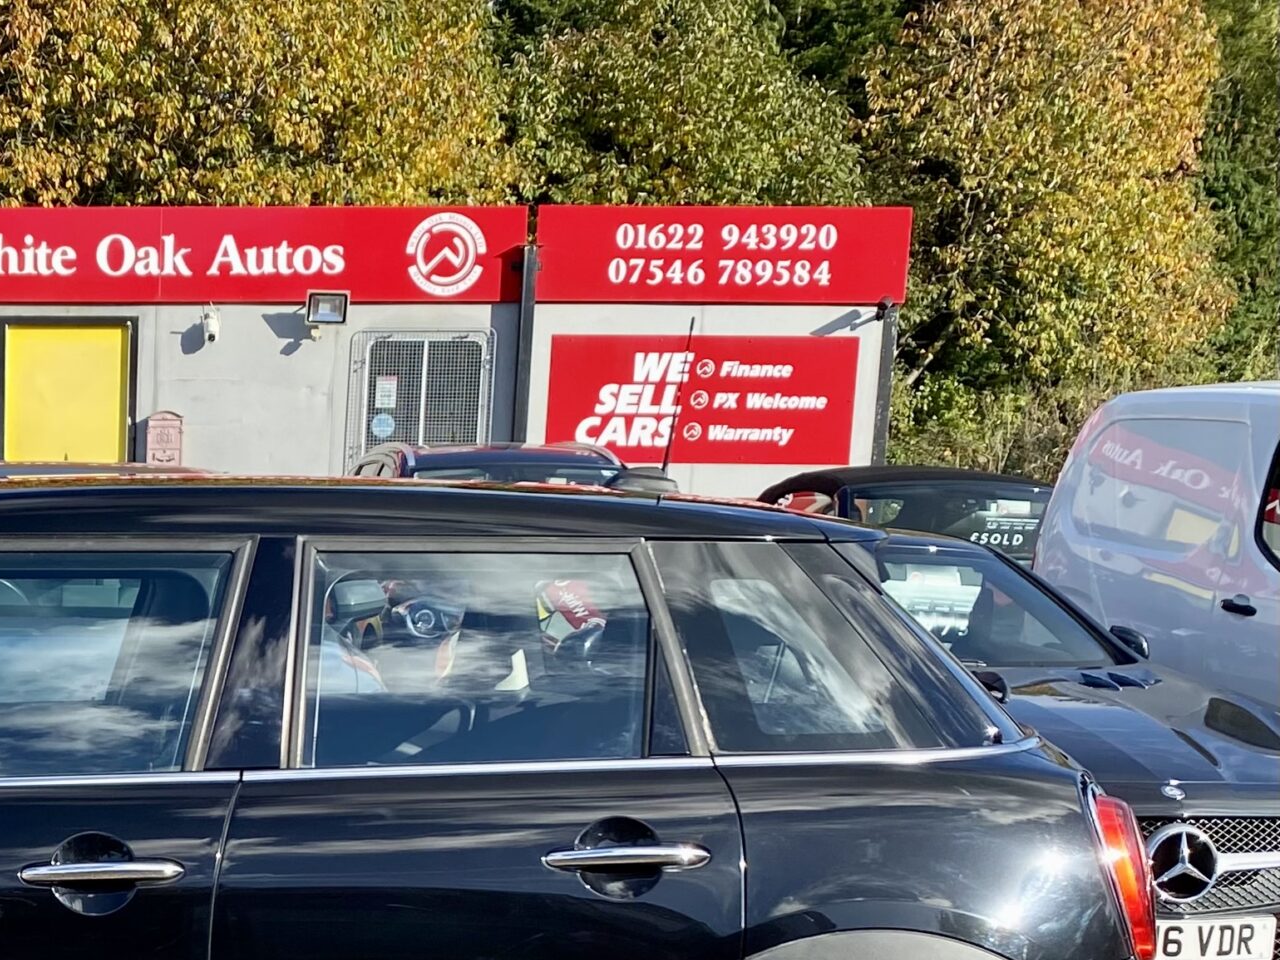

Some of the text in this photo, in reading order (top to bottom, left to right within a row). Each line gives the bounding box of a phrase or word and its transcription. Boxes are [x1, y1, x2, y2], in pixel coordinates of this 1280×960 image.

[615, 223, 838, 250] 01622 943920
[96, 233, 193, 277] Oak
[206, 233, 346, 276] Autos
[608, 258, 832, 286] 07546 789584
[633, 352, 695, 383] WE
[720, 361, 794, 379] Finance
[594, 383, 683, 416] SELL
[713, 393, 829, 411] PX Welcome
[575, 416, 680, 447] CARS
[707, 425, 795, 446] Warranty
[1198, 923, 1255, 957] VDR
